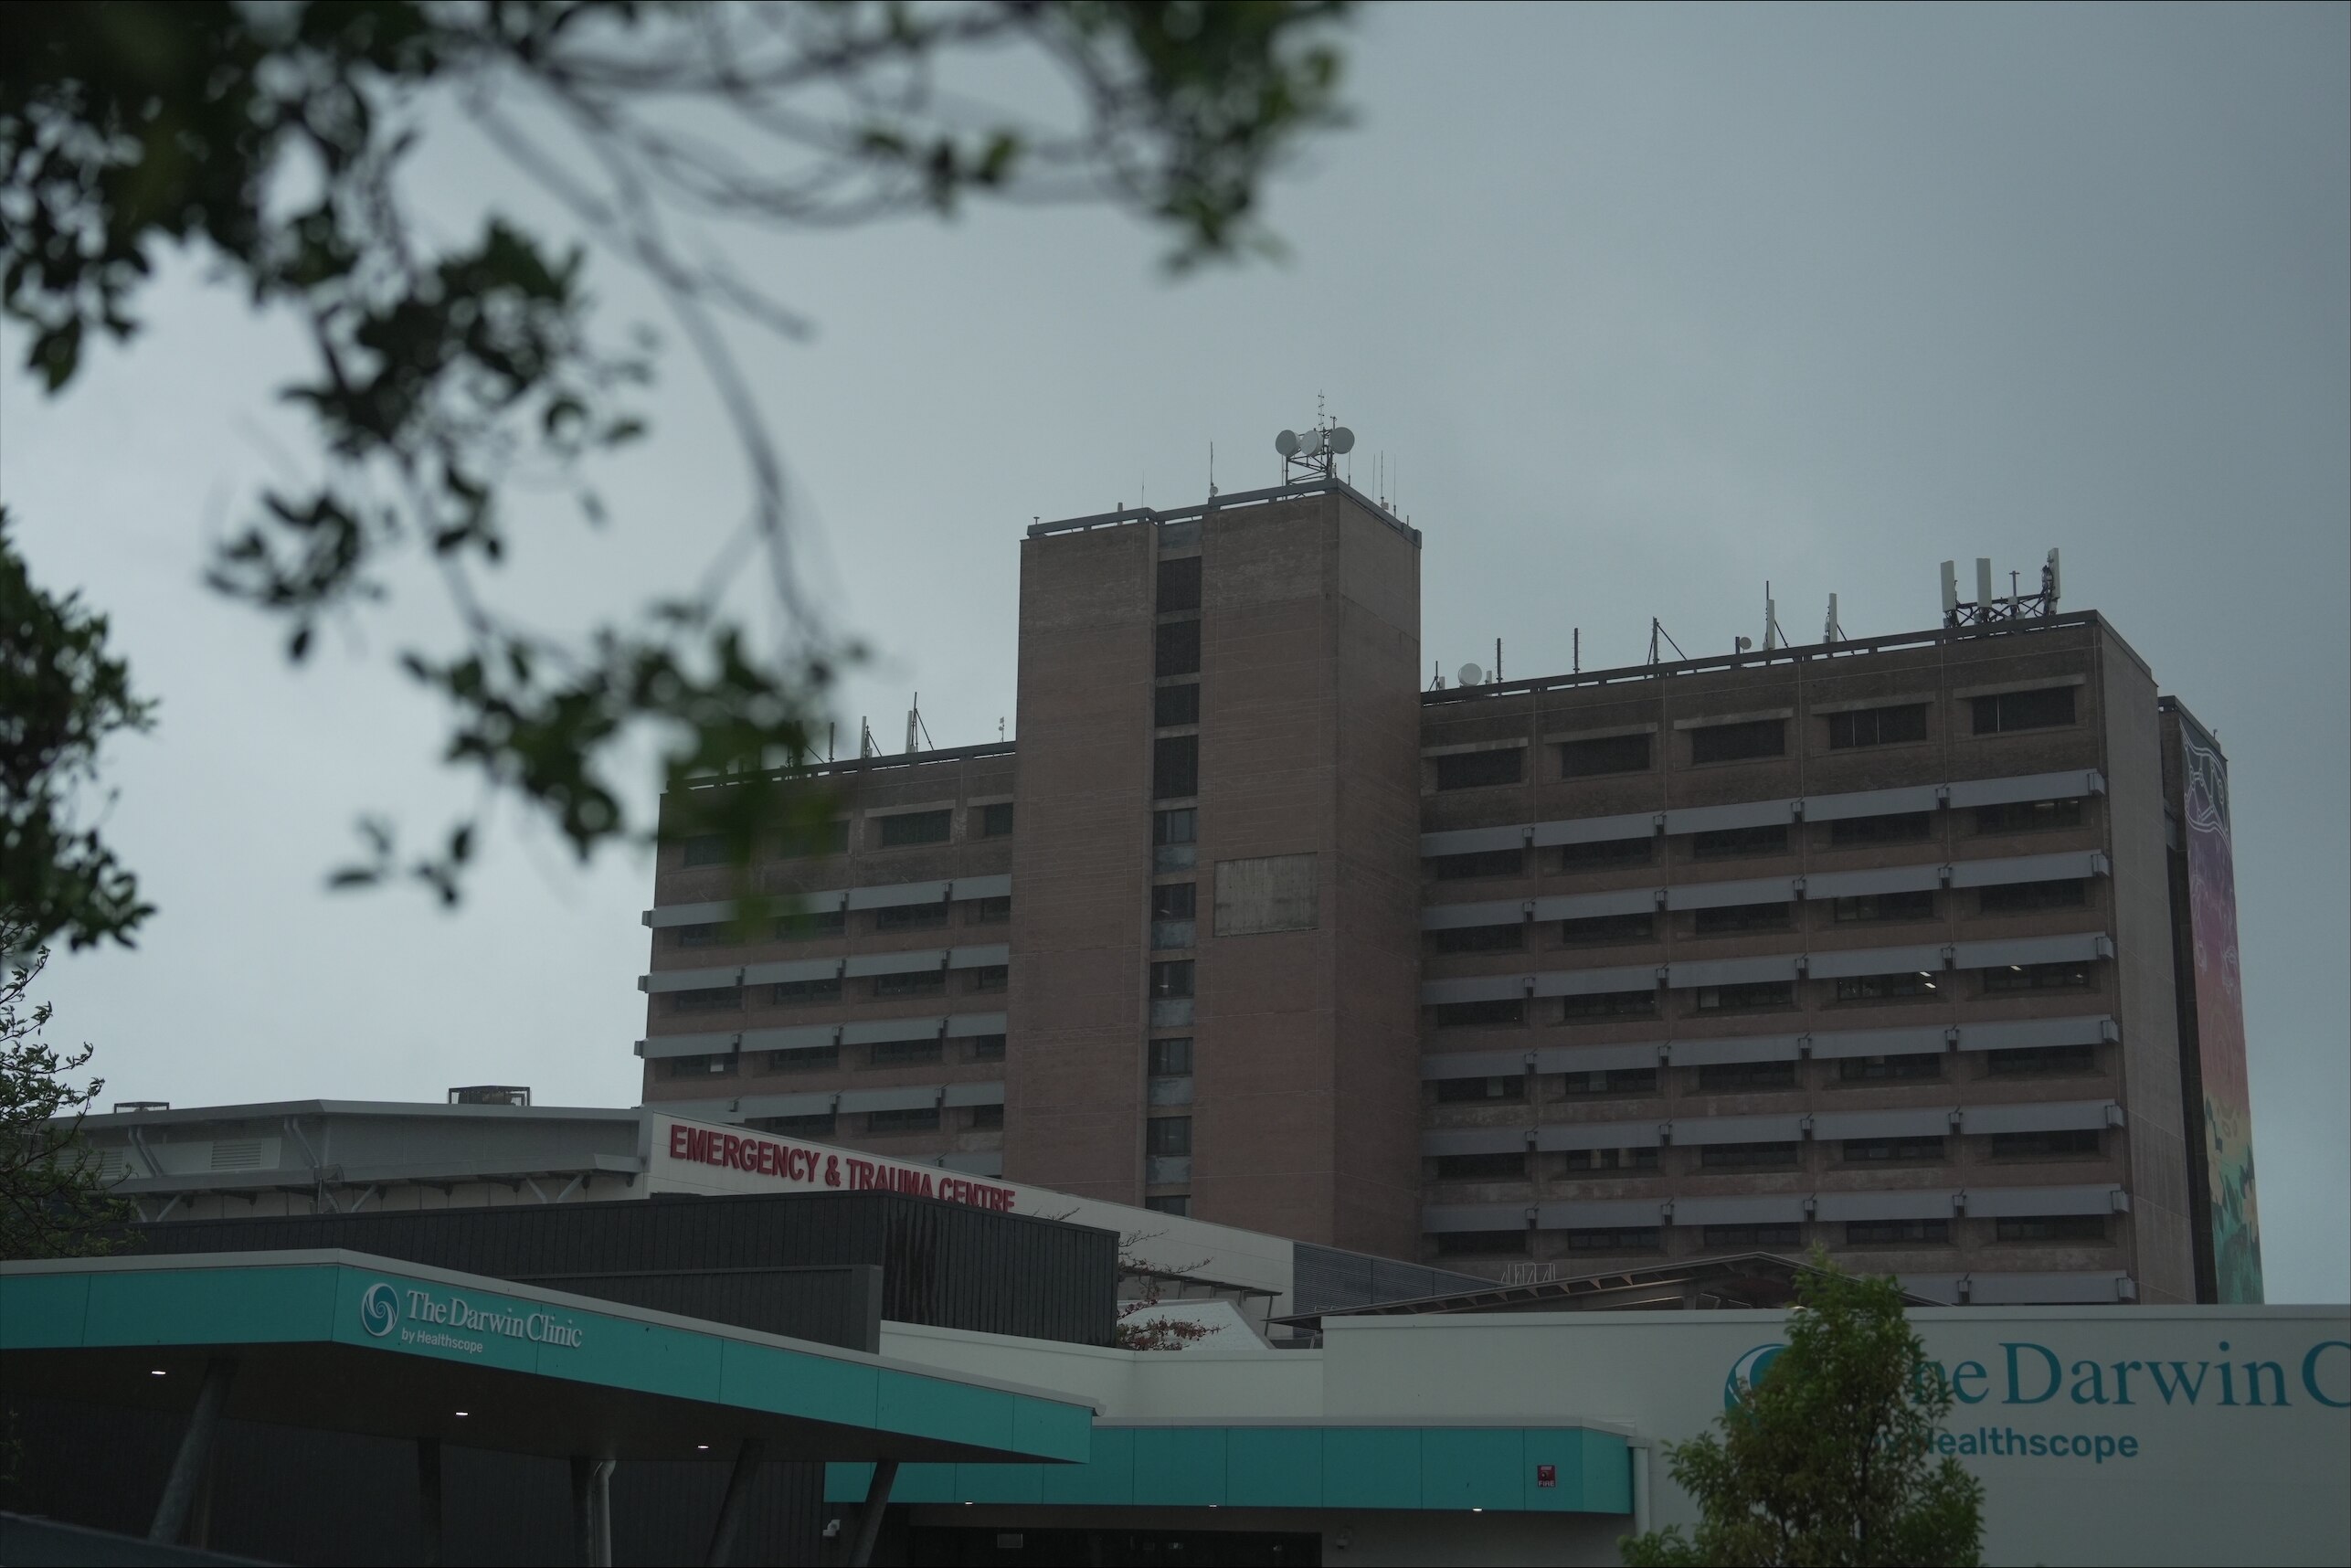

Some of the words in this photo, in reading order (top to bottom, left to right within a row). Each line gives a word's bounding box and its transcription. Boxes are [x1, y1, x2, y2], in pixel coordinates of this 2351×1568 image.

[670, 1124, 821, 1182] EMERGENCY
[825, 1154, 842, 1187] &
[846, 1158, 934, 1199] TRAUMA
[938, 1177, 1016, 1213] CENTRE
[401, 1327, 416, 1344] by
[417, 1330, 483, 1353] Healthscope
[407, 1290, 447, 1324] The
[448, 1298, 524, 1339] Darwin
[526, 1313, 583, 1349] Clinic
[1907, 1342, 1990, 1405] he
[1999, 1340, 2292, 1406] Darwin
